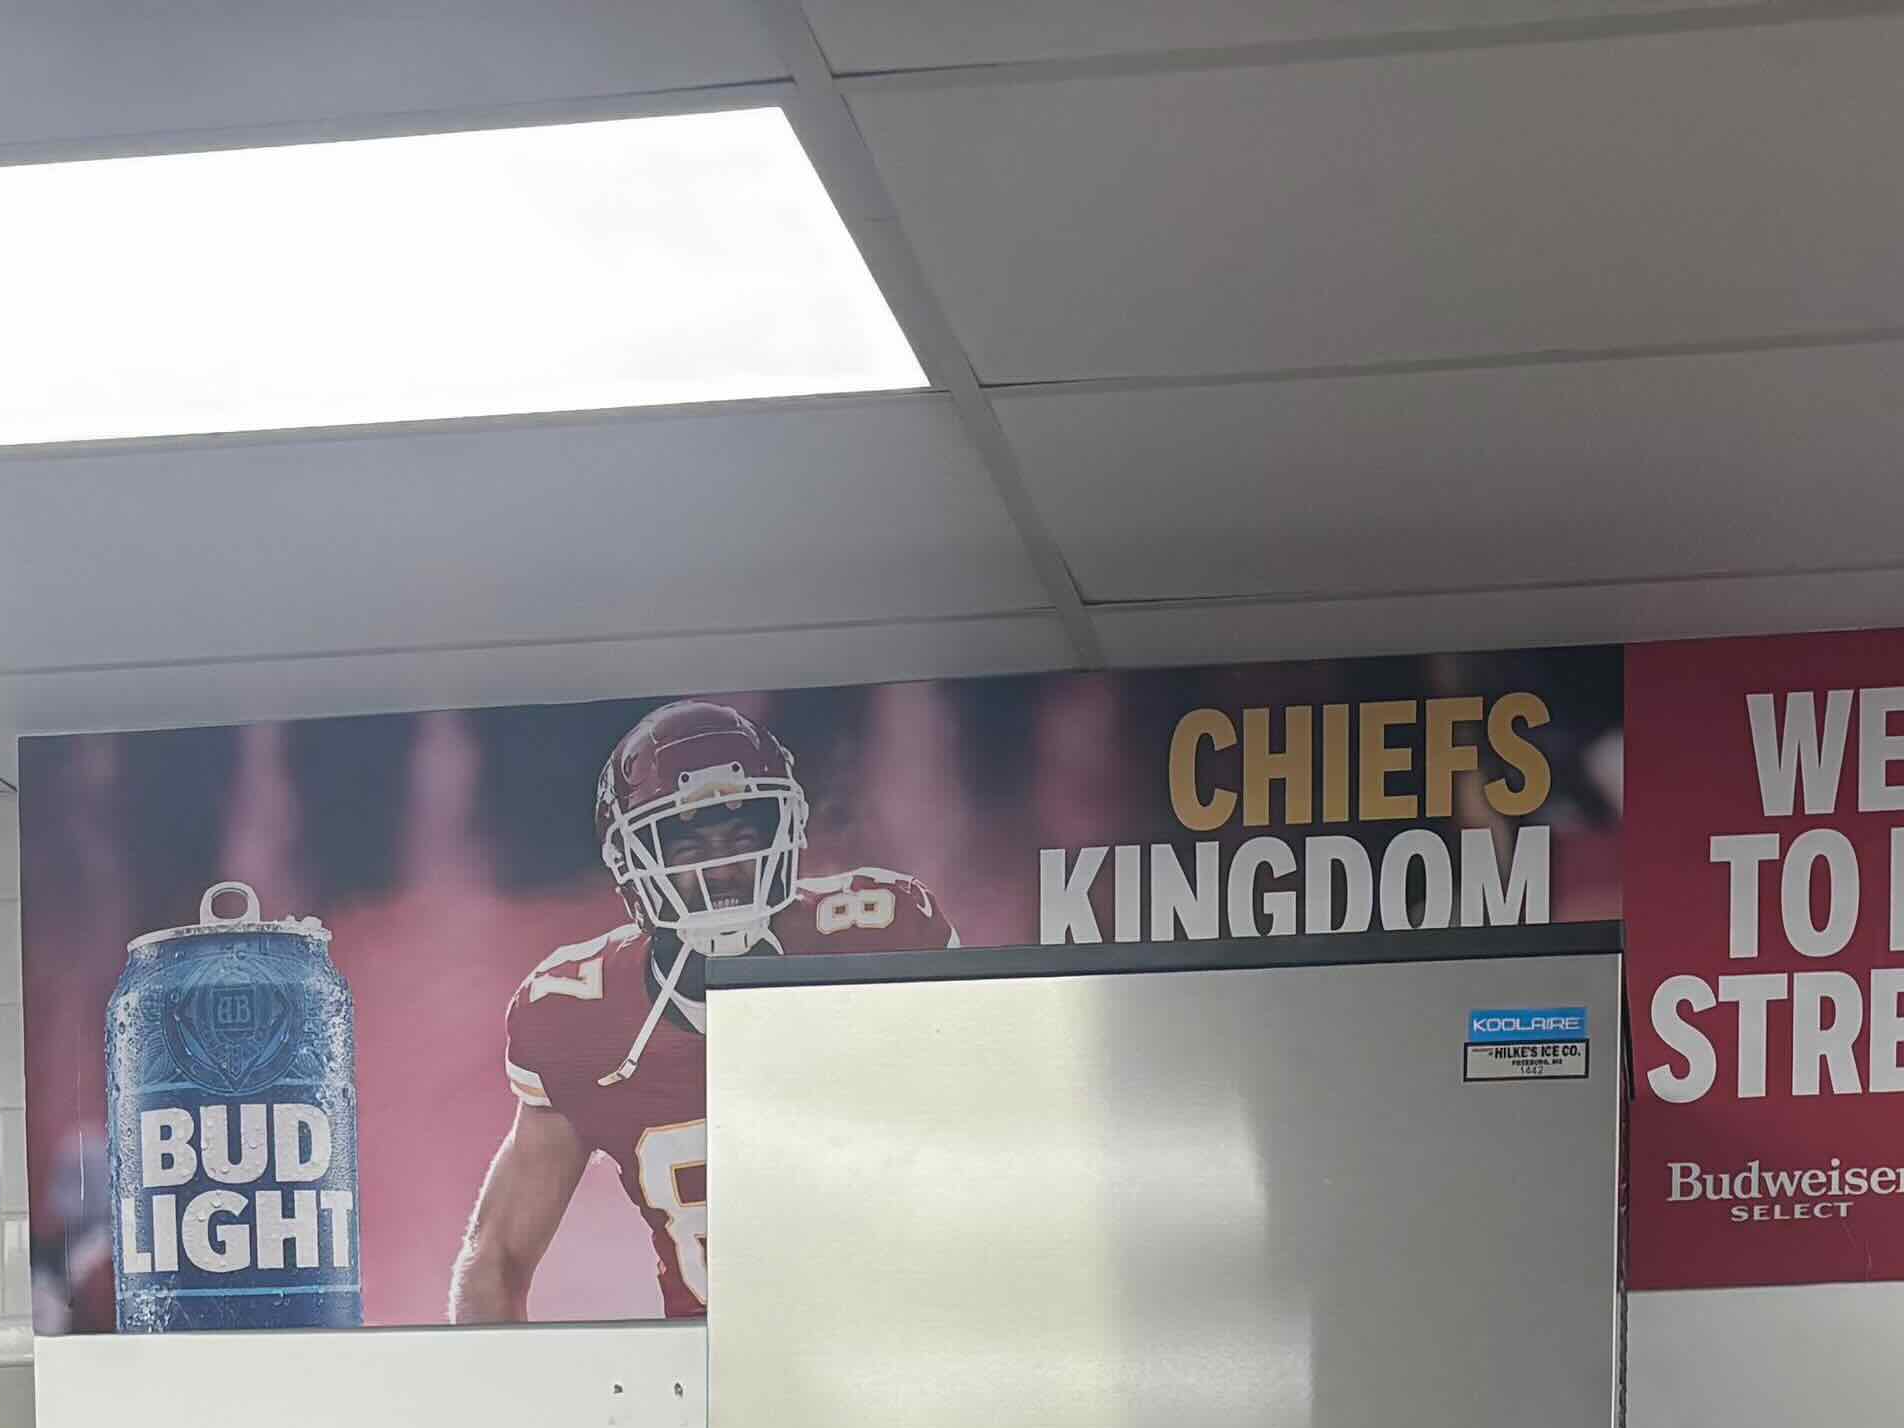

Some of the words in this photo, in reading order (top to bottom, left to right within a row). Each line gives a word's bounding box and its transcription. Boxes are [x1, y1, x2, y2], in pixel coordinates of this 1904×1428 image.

[1170, 687, 1551, 830] CHIEFS
[1040, 825, 1551, 945] KINGDOM
[1708, 828, 1860, 959] TO
[1473, 1017, 1581, 1032] KOOLAIRE
[1495, 1047, 1537, 1059] HILKE'S
[1541, 1046, 1558, 1057] ICE
[1562, 1045, 1581, 1057] CO.
[141, 1104, 332, 1187] BUD
[122, 1191, 353, 1274] LIGHT
[1730, 1202, 1853, 1222] SELECT
